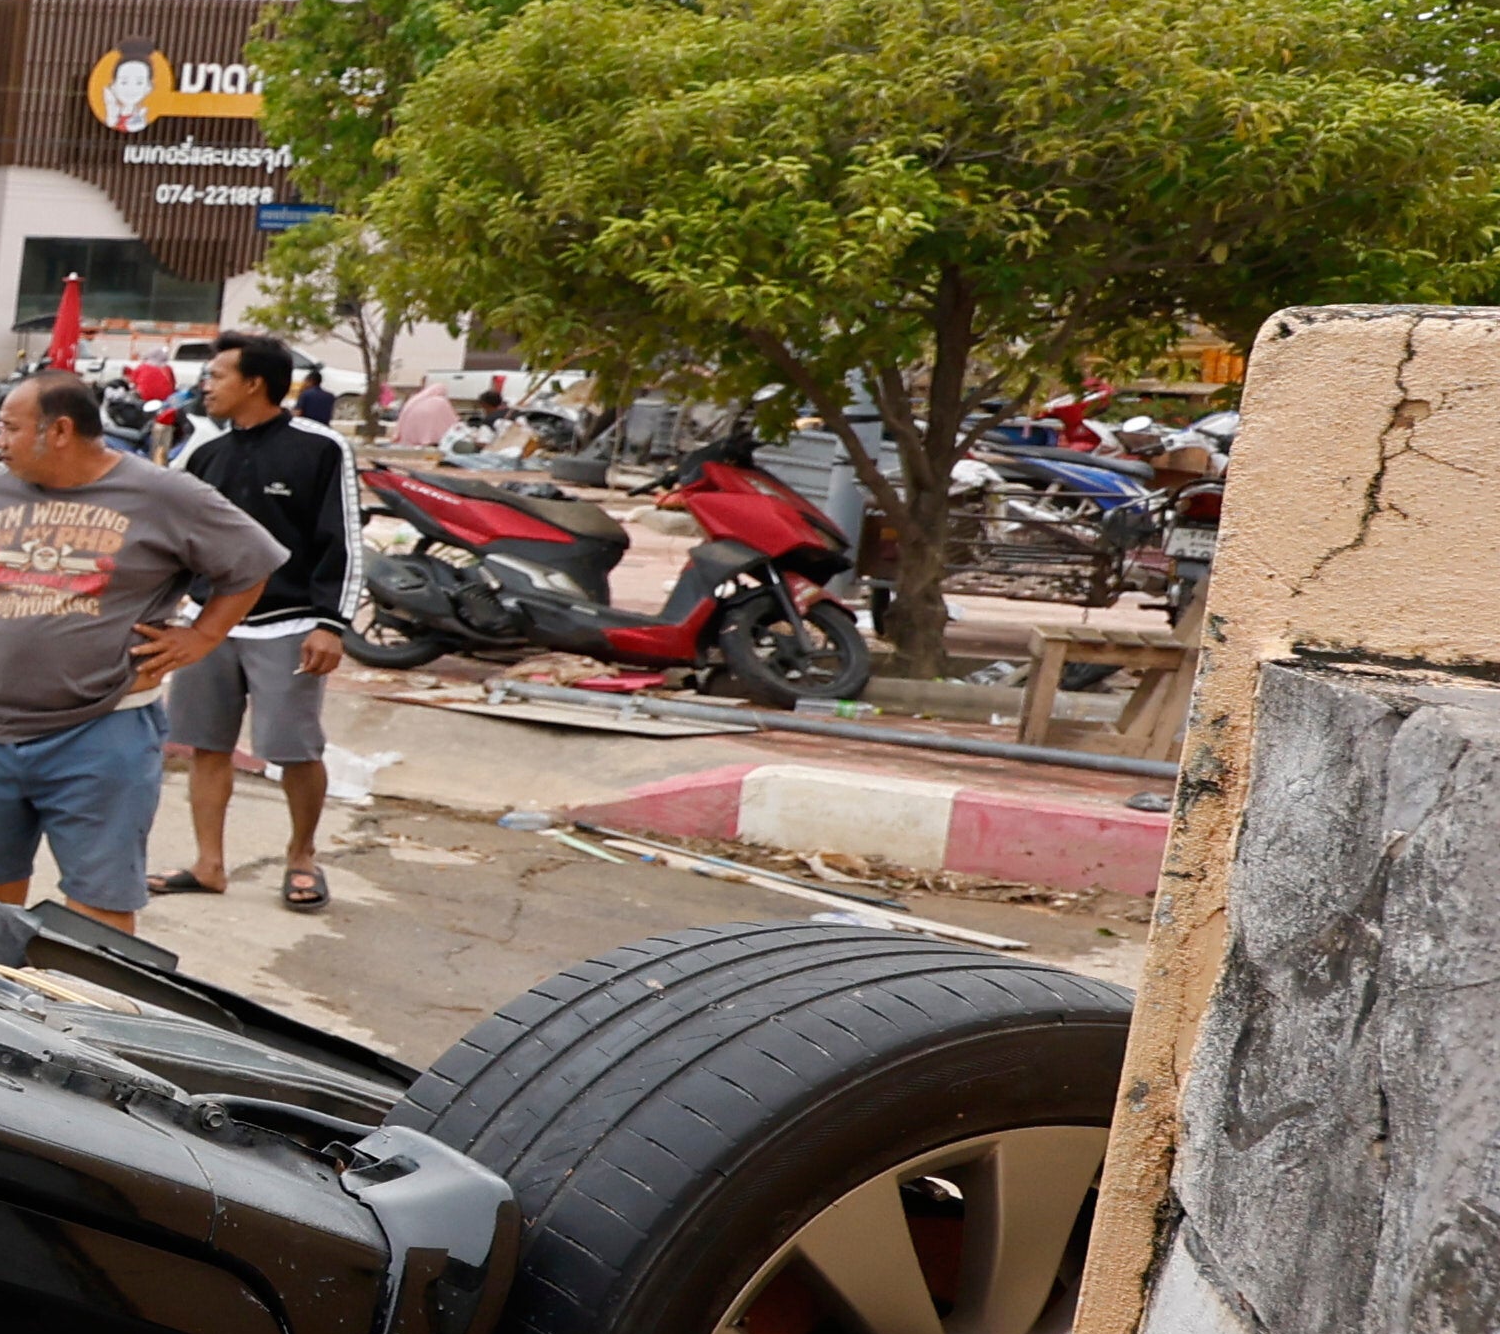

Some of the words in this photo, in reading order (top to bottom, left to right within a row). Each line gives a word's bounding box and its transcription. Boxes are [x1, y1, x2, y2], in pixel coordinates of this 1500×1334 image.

[123, 135, 294, 174] เบเกอรี่และบรรจุภั
[31, 501, 131, 534] WORKING
[54, 525, 125, 555] PHD
